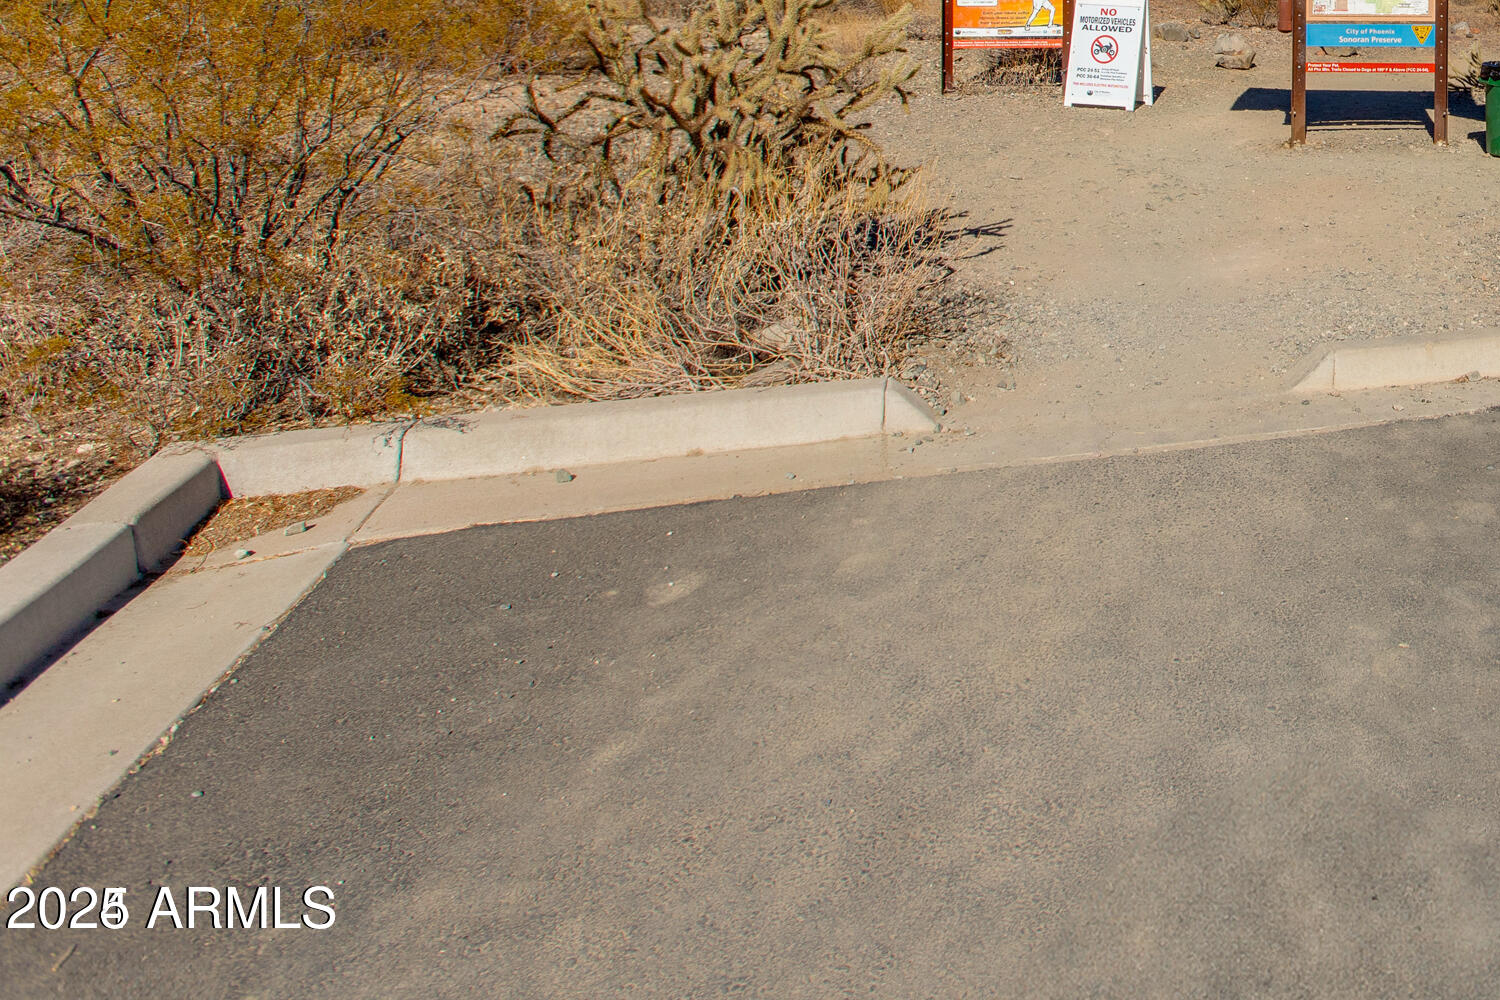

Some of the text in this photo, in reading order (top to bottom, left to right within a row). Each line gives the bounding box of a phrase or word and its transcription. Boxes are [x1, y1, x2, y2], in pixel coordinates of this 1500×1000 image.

[1100, 8, 1117, 16] NO
[1080, 16, 1136, 26] MOTORIZED VEHICLES
[1082, 24, 1132, 33] ALLOWED
